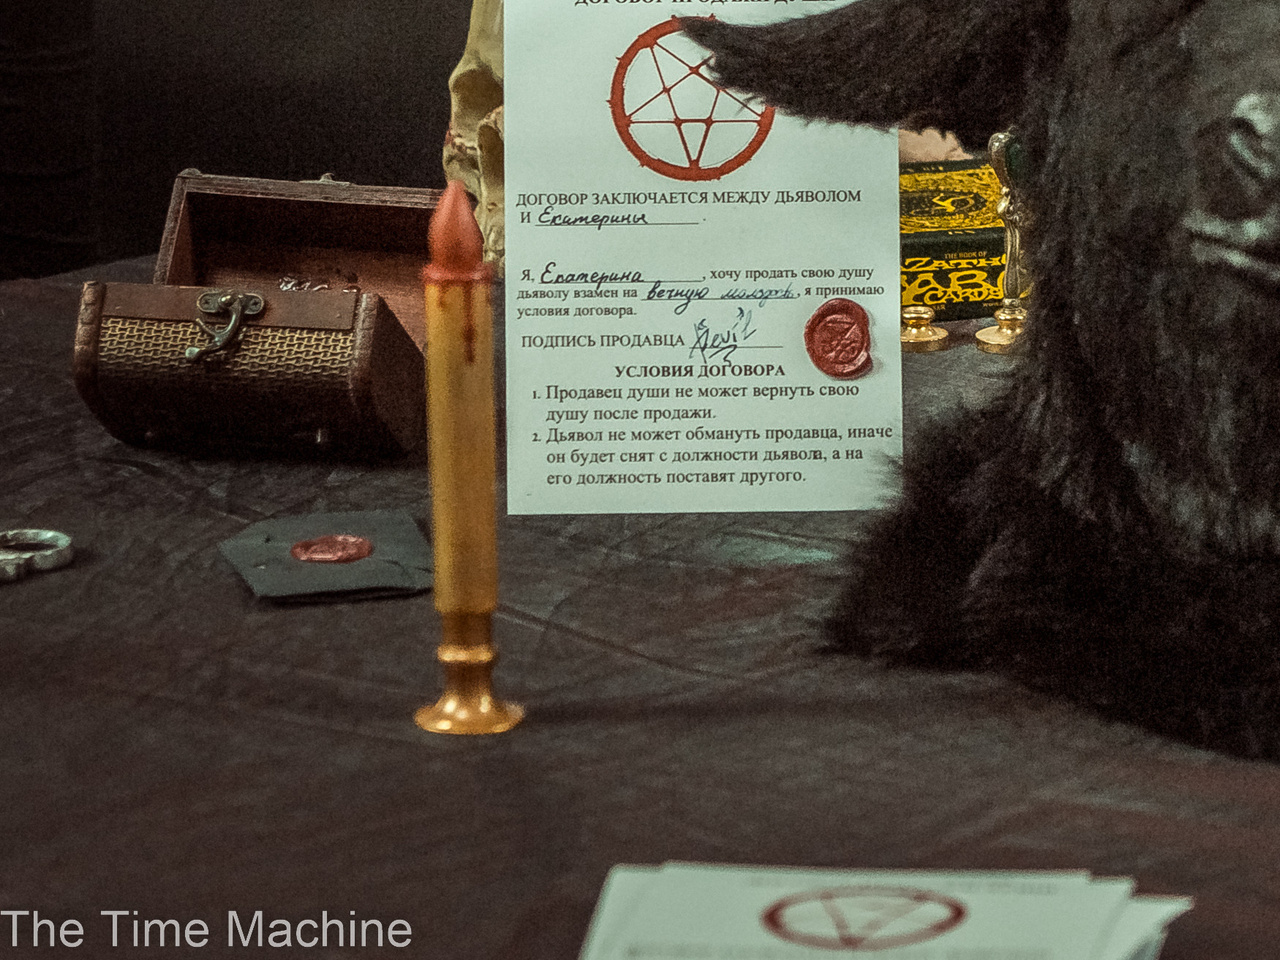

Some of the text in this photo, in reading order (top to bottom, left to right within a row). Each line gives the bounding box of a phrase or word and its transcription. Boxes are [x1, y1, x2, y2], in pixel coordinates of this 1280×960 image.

[516, 190, 861, 207] ДОГОВОР ЗАКЛЮЧАЕТСЯ МЕЖДУ ДЬЯВОЛОМ
[520, 212, 531, 223] И
[538, 206, 648, 230] Екатерины
[521, 269, 535, 282] Я,
[540, 261, 645, 290] Екатерина
[710, 268, 874, 281] хочу продать свою душу
[517, 289, 638, 302] дьяволу взамен на
[804, 286, 885, 299] я принимаю
[517, 307, 637, 319] условия договора.
[521, 334, 685, 349] ПОДПИСЬ ПРОДАВЦА
[615, 364, 785, 378] УСЛОВИЯ ДОГОВОРА
[545, 385, 622, 403] Продавец
[627, 388, 670, 402] души
[675, 387, 693, 398] не
[698, 386, 747, 397] может
[753, 385, 814, 400] вернуть
[819, 385, 859, 397] свою
[546, 408, 716, 424] душу после продажи.
[546, 428, 603, 444] Дьявол
[608, 430, 626, 441] не
[631, 430, 680, 441] может
[685, 426, 760, 443] обмануть
[765, 427, 842, 443] продавца,
[848, 427, 893, 439] иначе
[546, 453, 566, 464] он
[570, 449, 615, 466] будет
[619, 452, 654, 463] снят
[659, 451, 667, 462] с
[672, 450, 758, 463] должности
[832, 449, 840, 460] а
[845, 449, 863, 460] на
[546, 470, 806, 486] его должность поставят другого.
